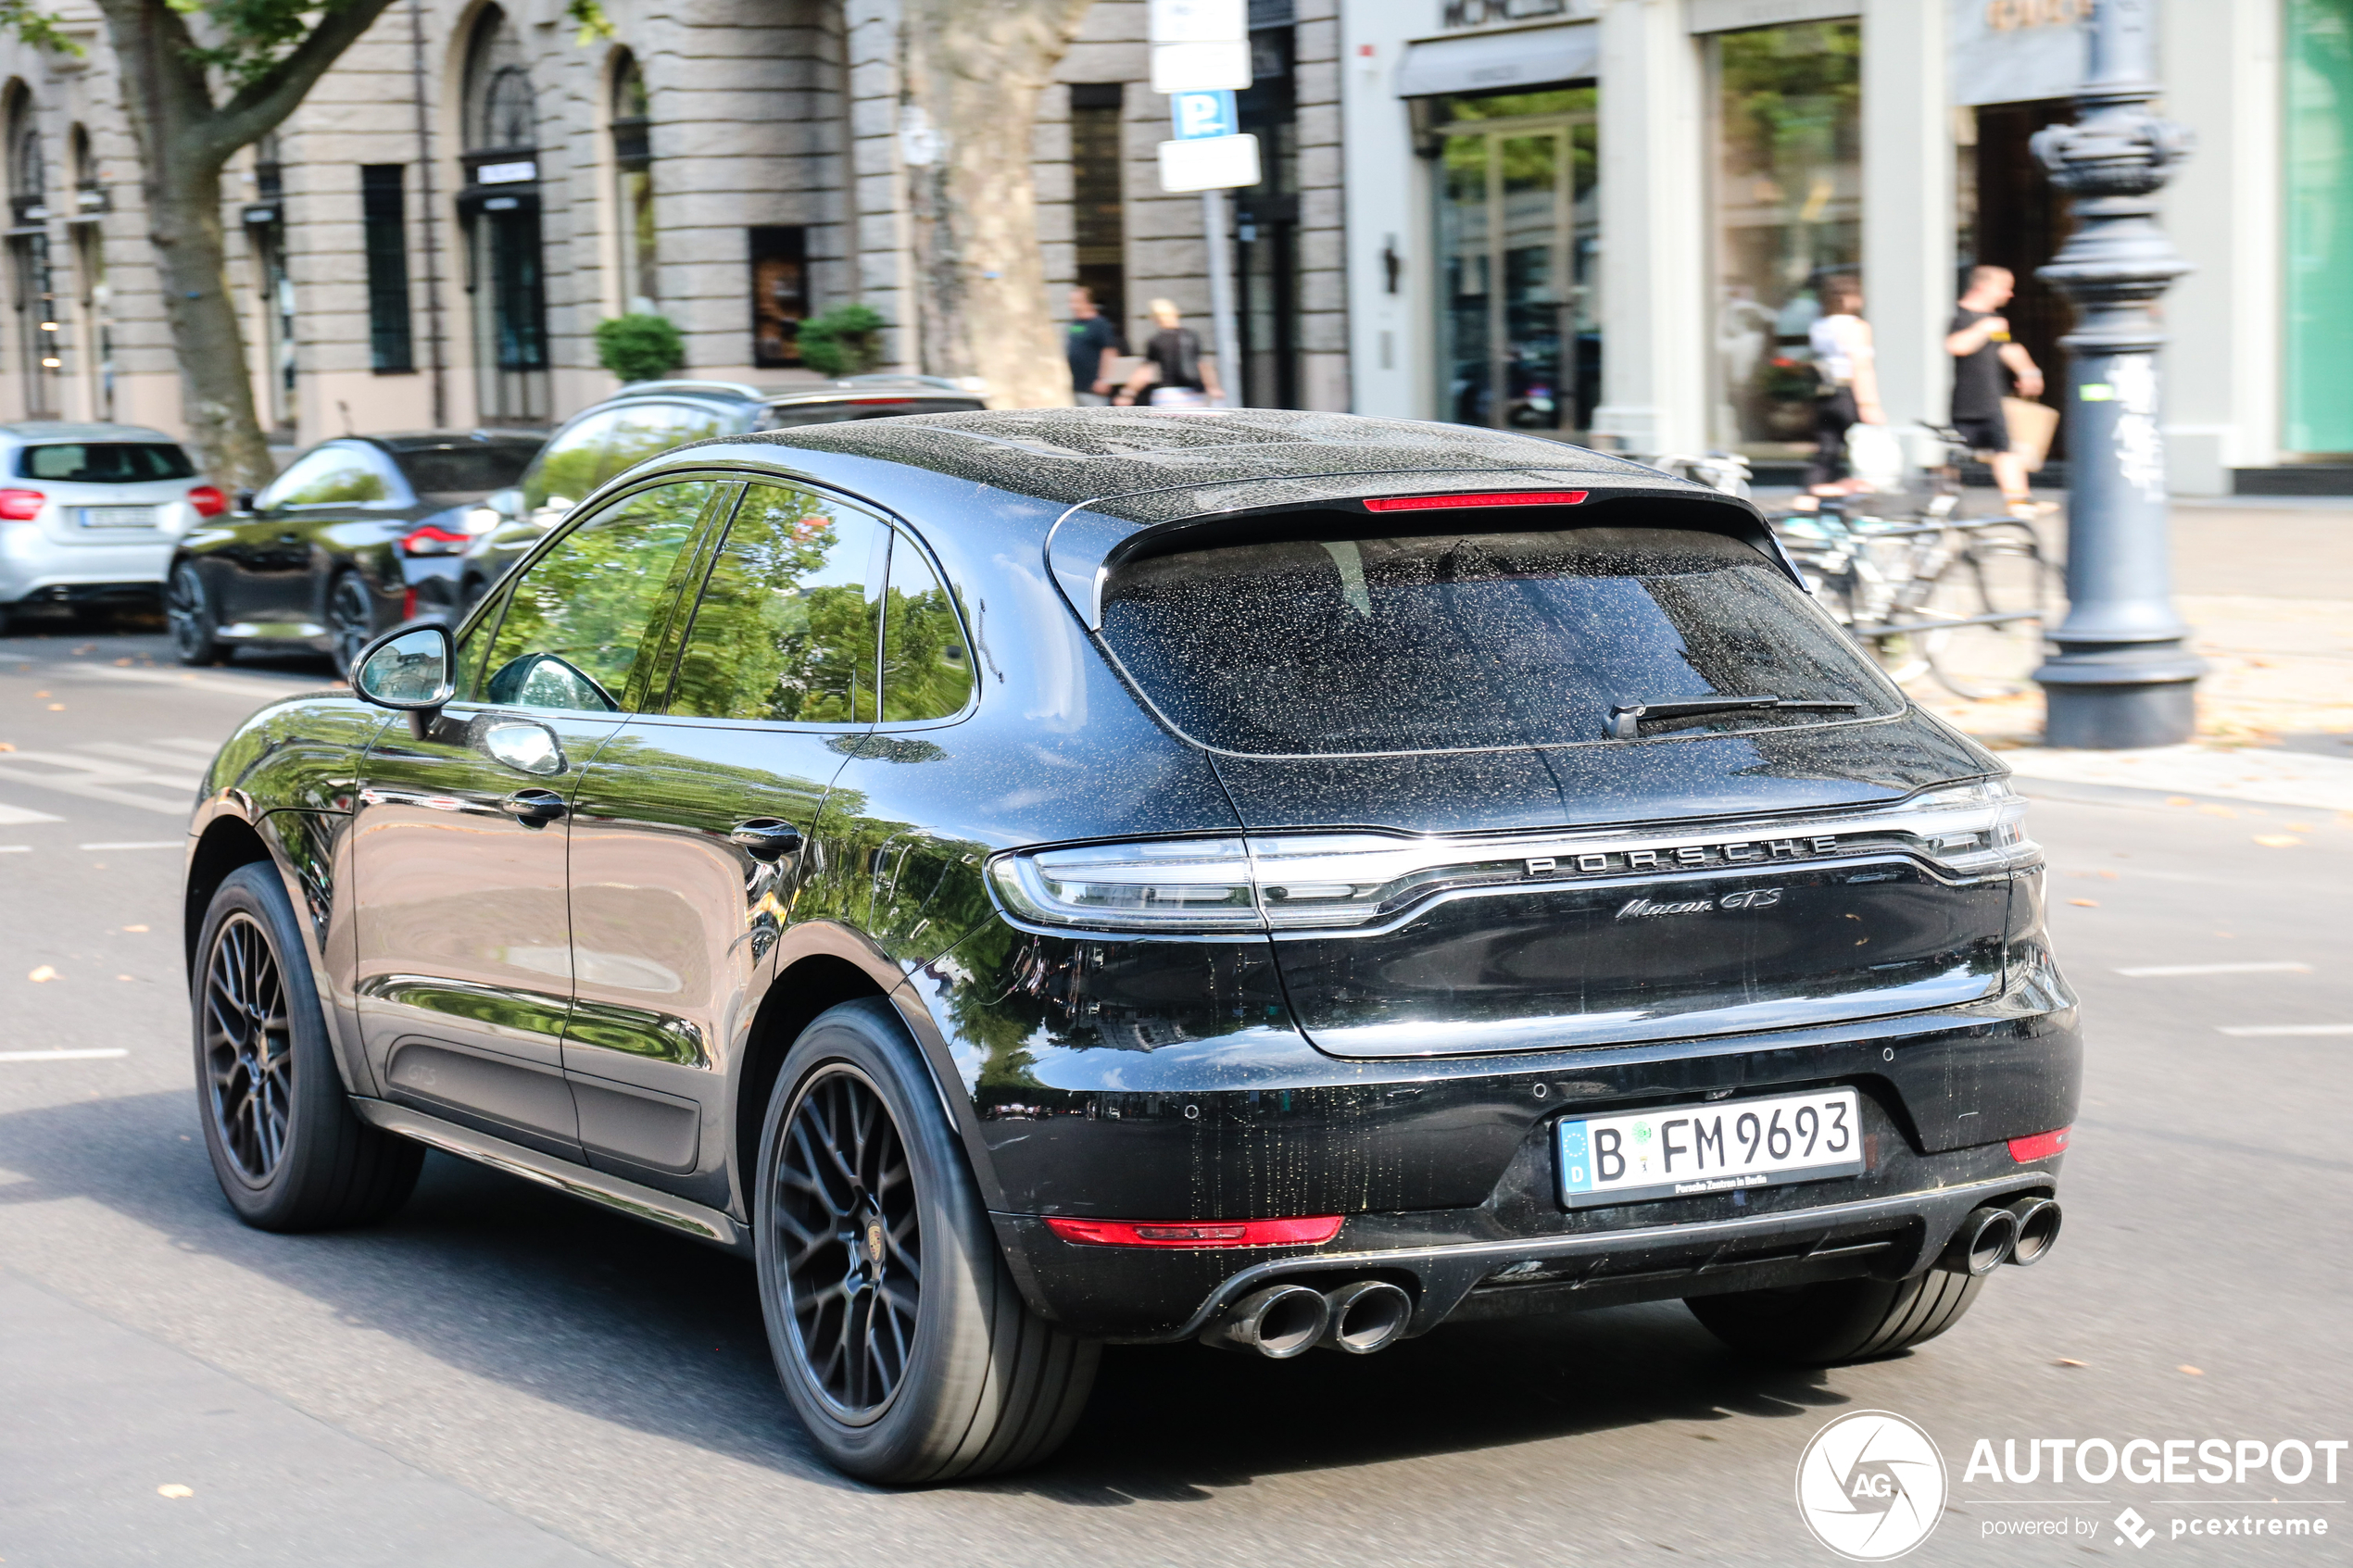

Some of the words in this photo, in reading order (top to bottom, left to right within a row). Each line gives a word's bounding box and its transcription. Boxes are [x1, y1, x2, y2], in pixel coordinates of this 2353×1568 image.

[1525, 835, 1837, 876] PORSCHE
[1615, 897, 1713, 919] Macan
[1719, 887, 1784, 910] GTS
[1593, 1127, 1626, 1183] B
[1571, 1166, 1583, 1183] D
[1675, 1182, 1706, 1194] Porsche
[1706, 1180, 1736, 1190] Zentren
[1737, 1177, 1744, 1186] in
[1744, 1174, 1767, 1185] Berlin
